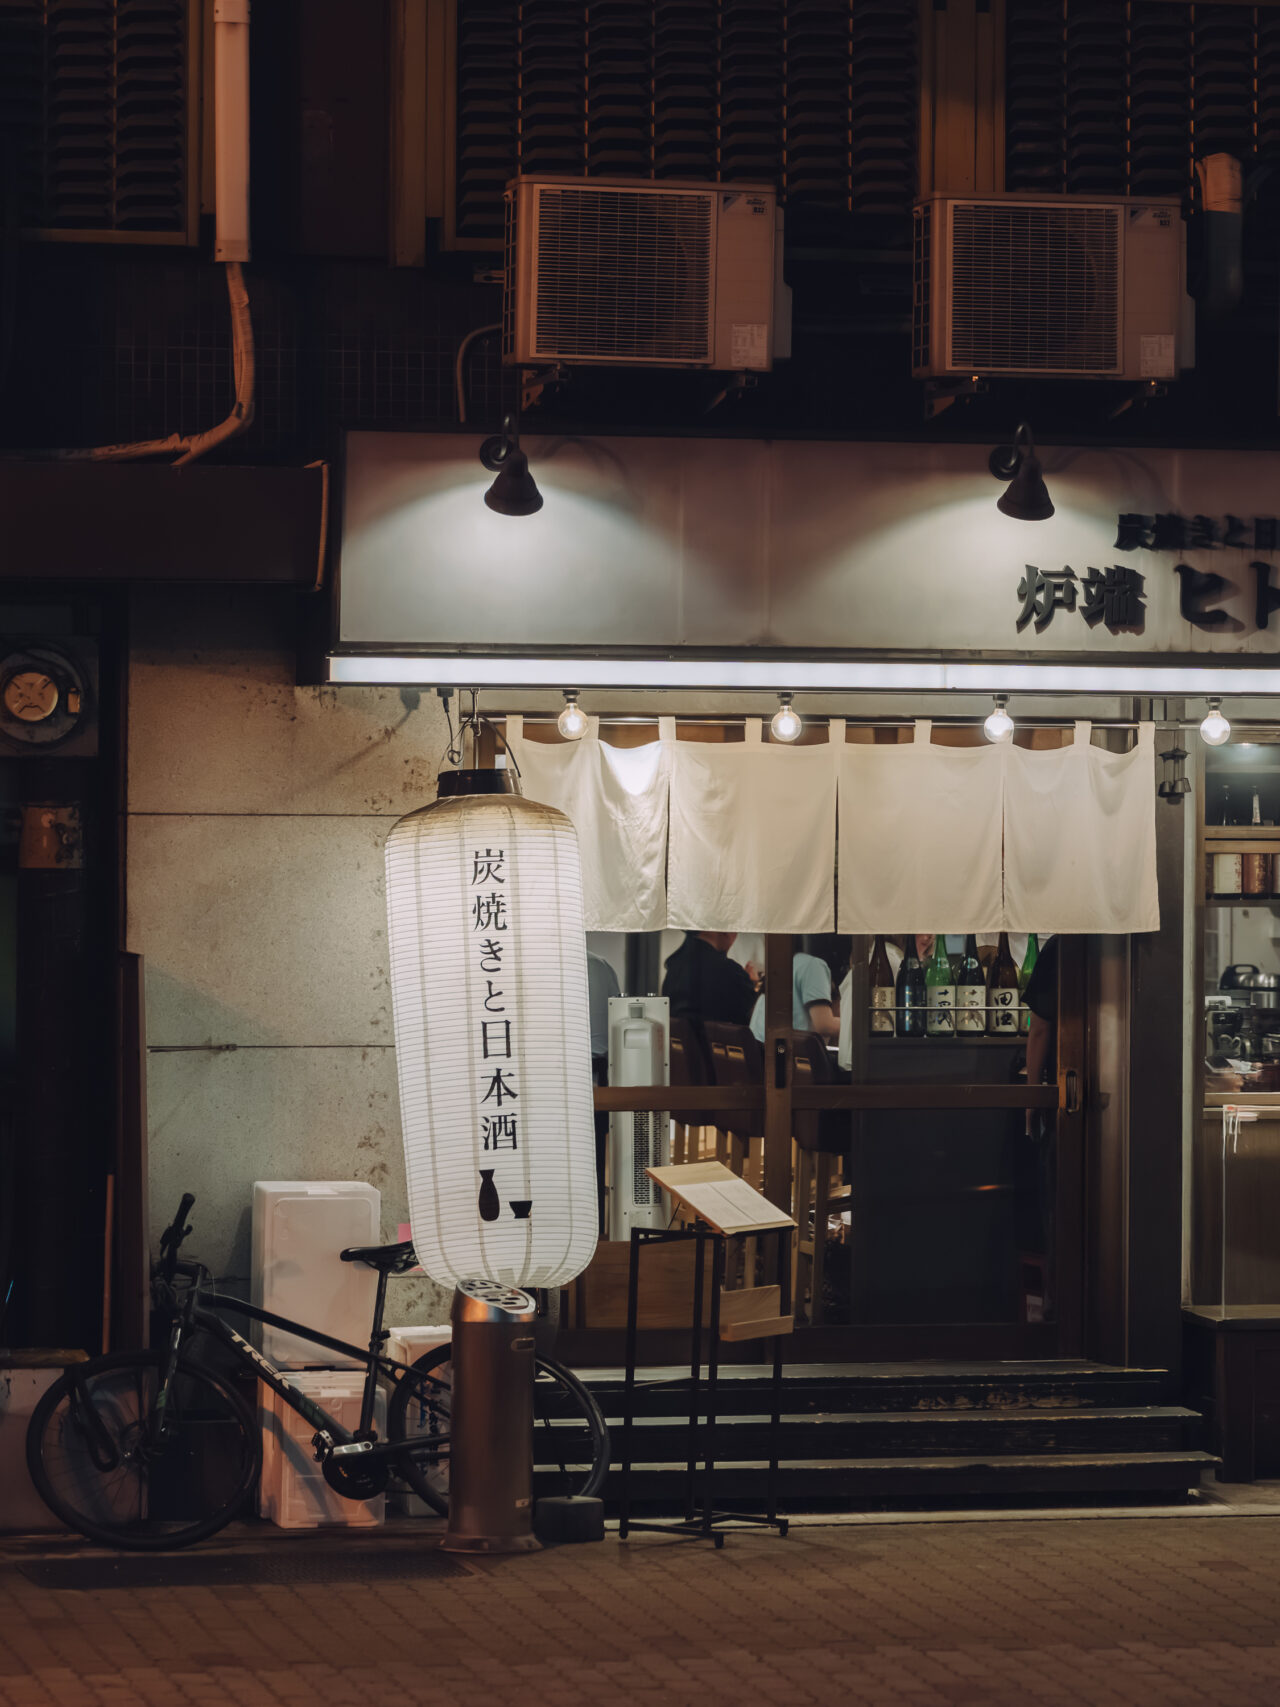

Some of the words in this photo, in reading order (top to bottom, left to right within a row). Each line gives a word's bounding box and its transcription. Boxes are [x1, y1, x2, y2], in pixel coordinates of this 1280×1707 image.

[1015, 564, 1146, 633] 炉端
[471, 848, 519, 1151] 炭焼きと日本酒
[231, 1329, 290, 1391] TREK
